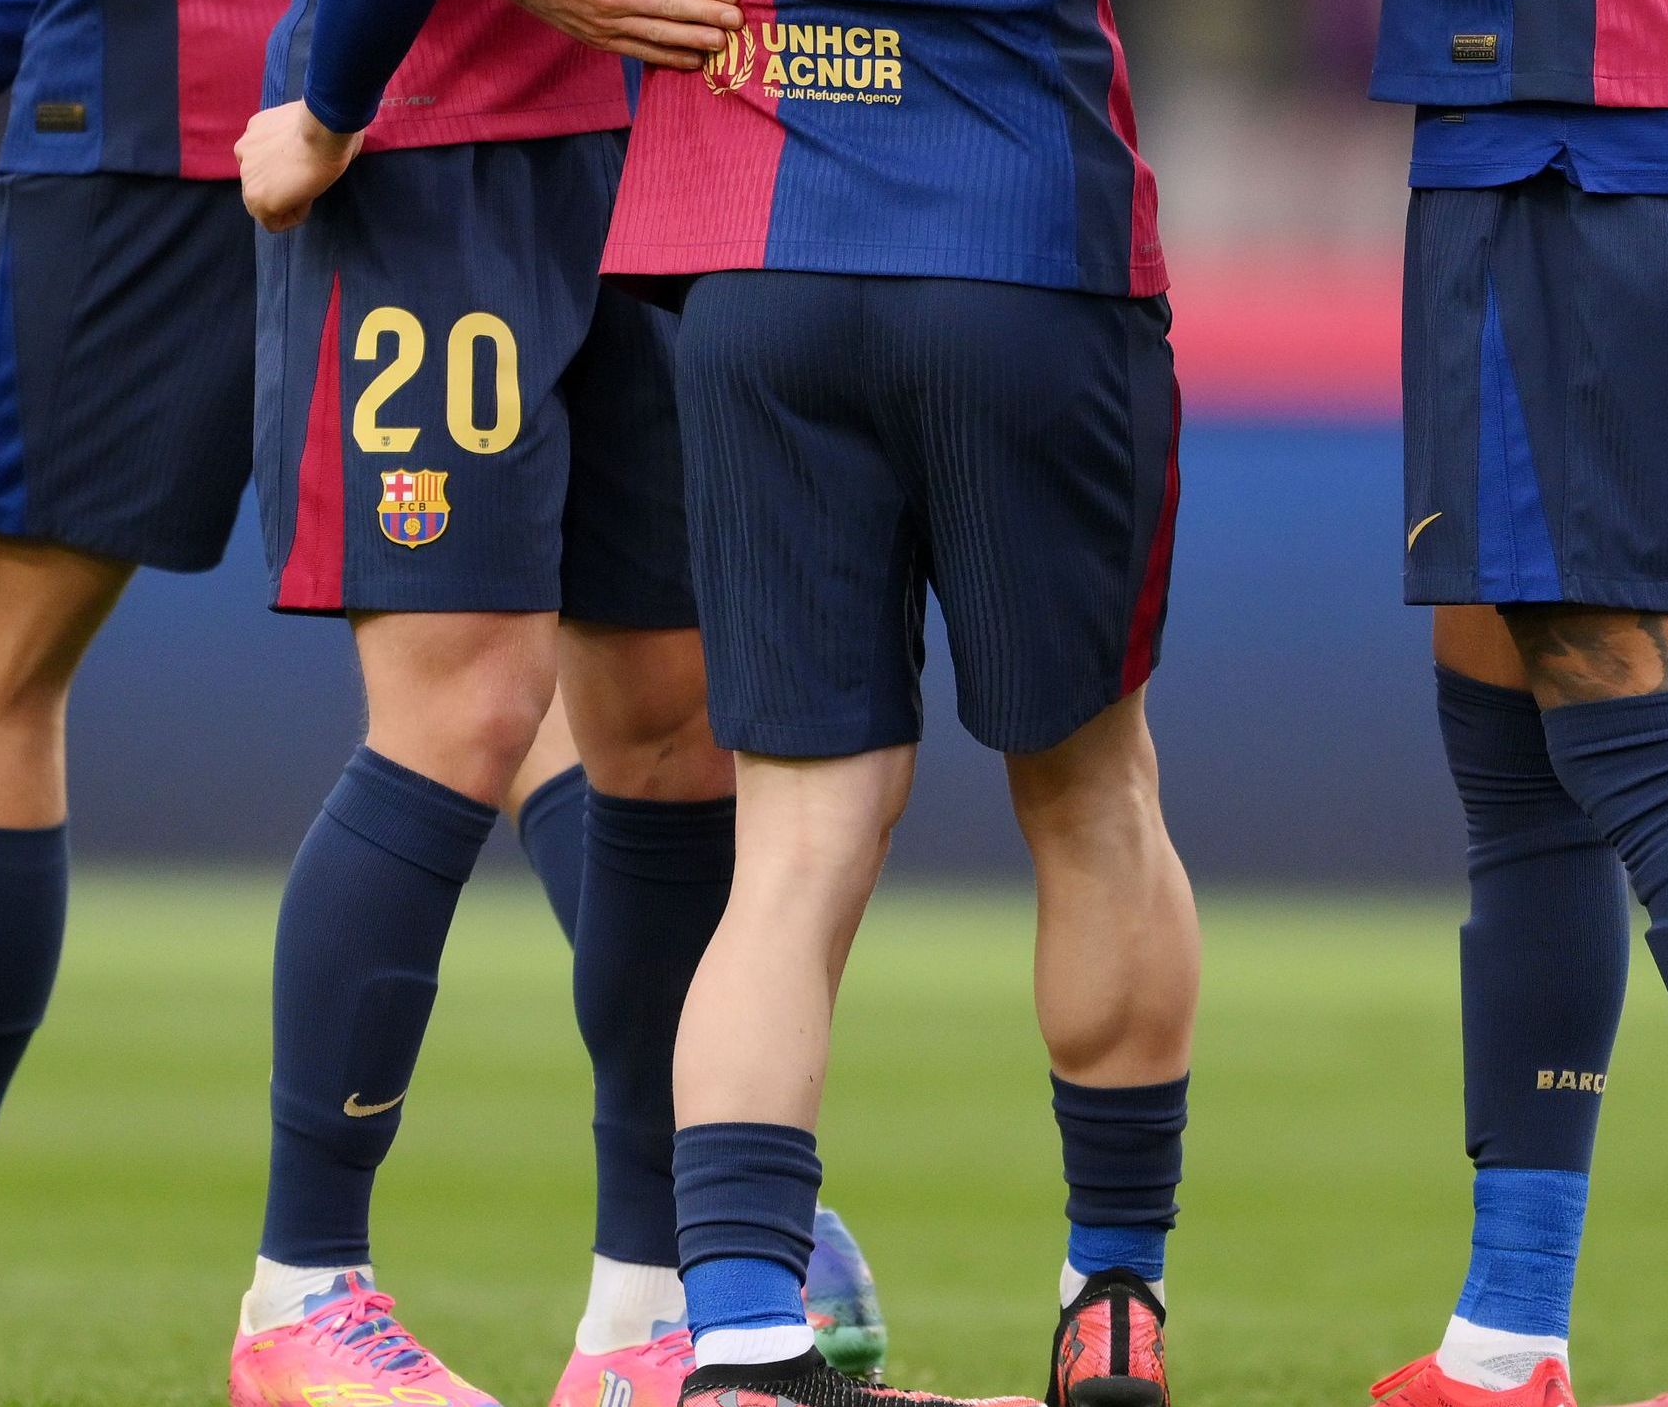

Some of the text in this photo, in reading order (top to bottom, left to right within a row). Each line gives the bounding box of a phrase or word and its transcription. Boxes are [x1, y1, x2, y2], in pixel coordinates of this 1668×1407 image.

[761, 22, 902, 58] UNHCR
[762, 54, 902, 90] ACNUR
[763, 86, 902, 105] The UN Refugee Agency
[352, 305, 522, 455] 20
